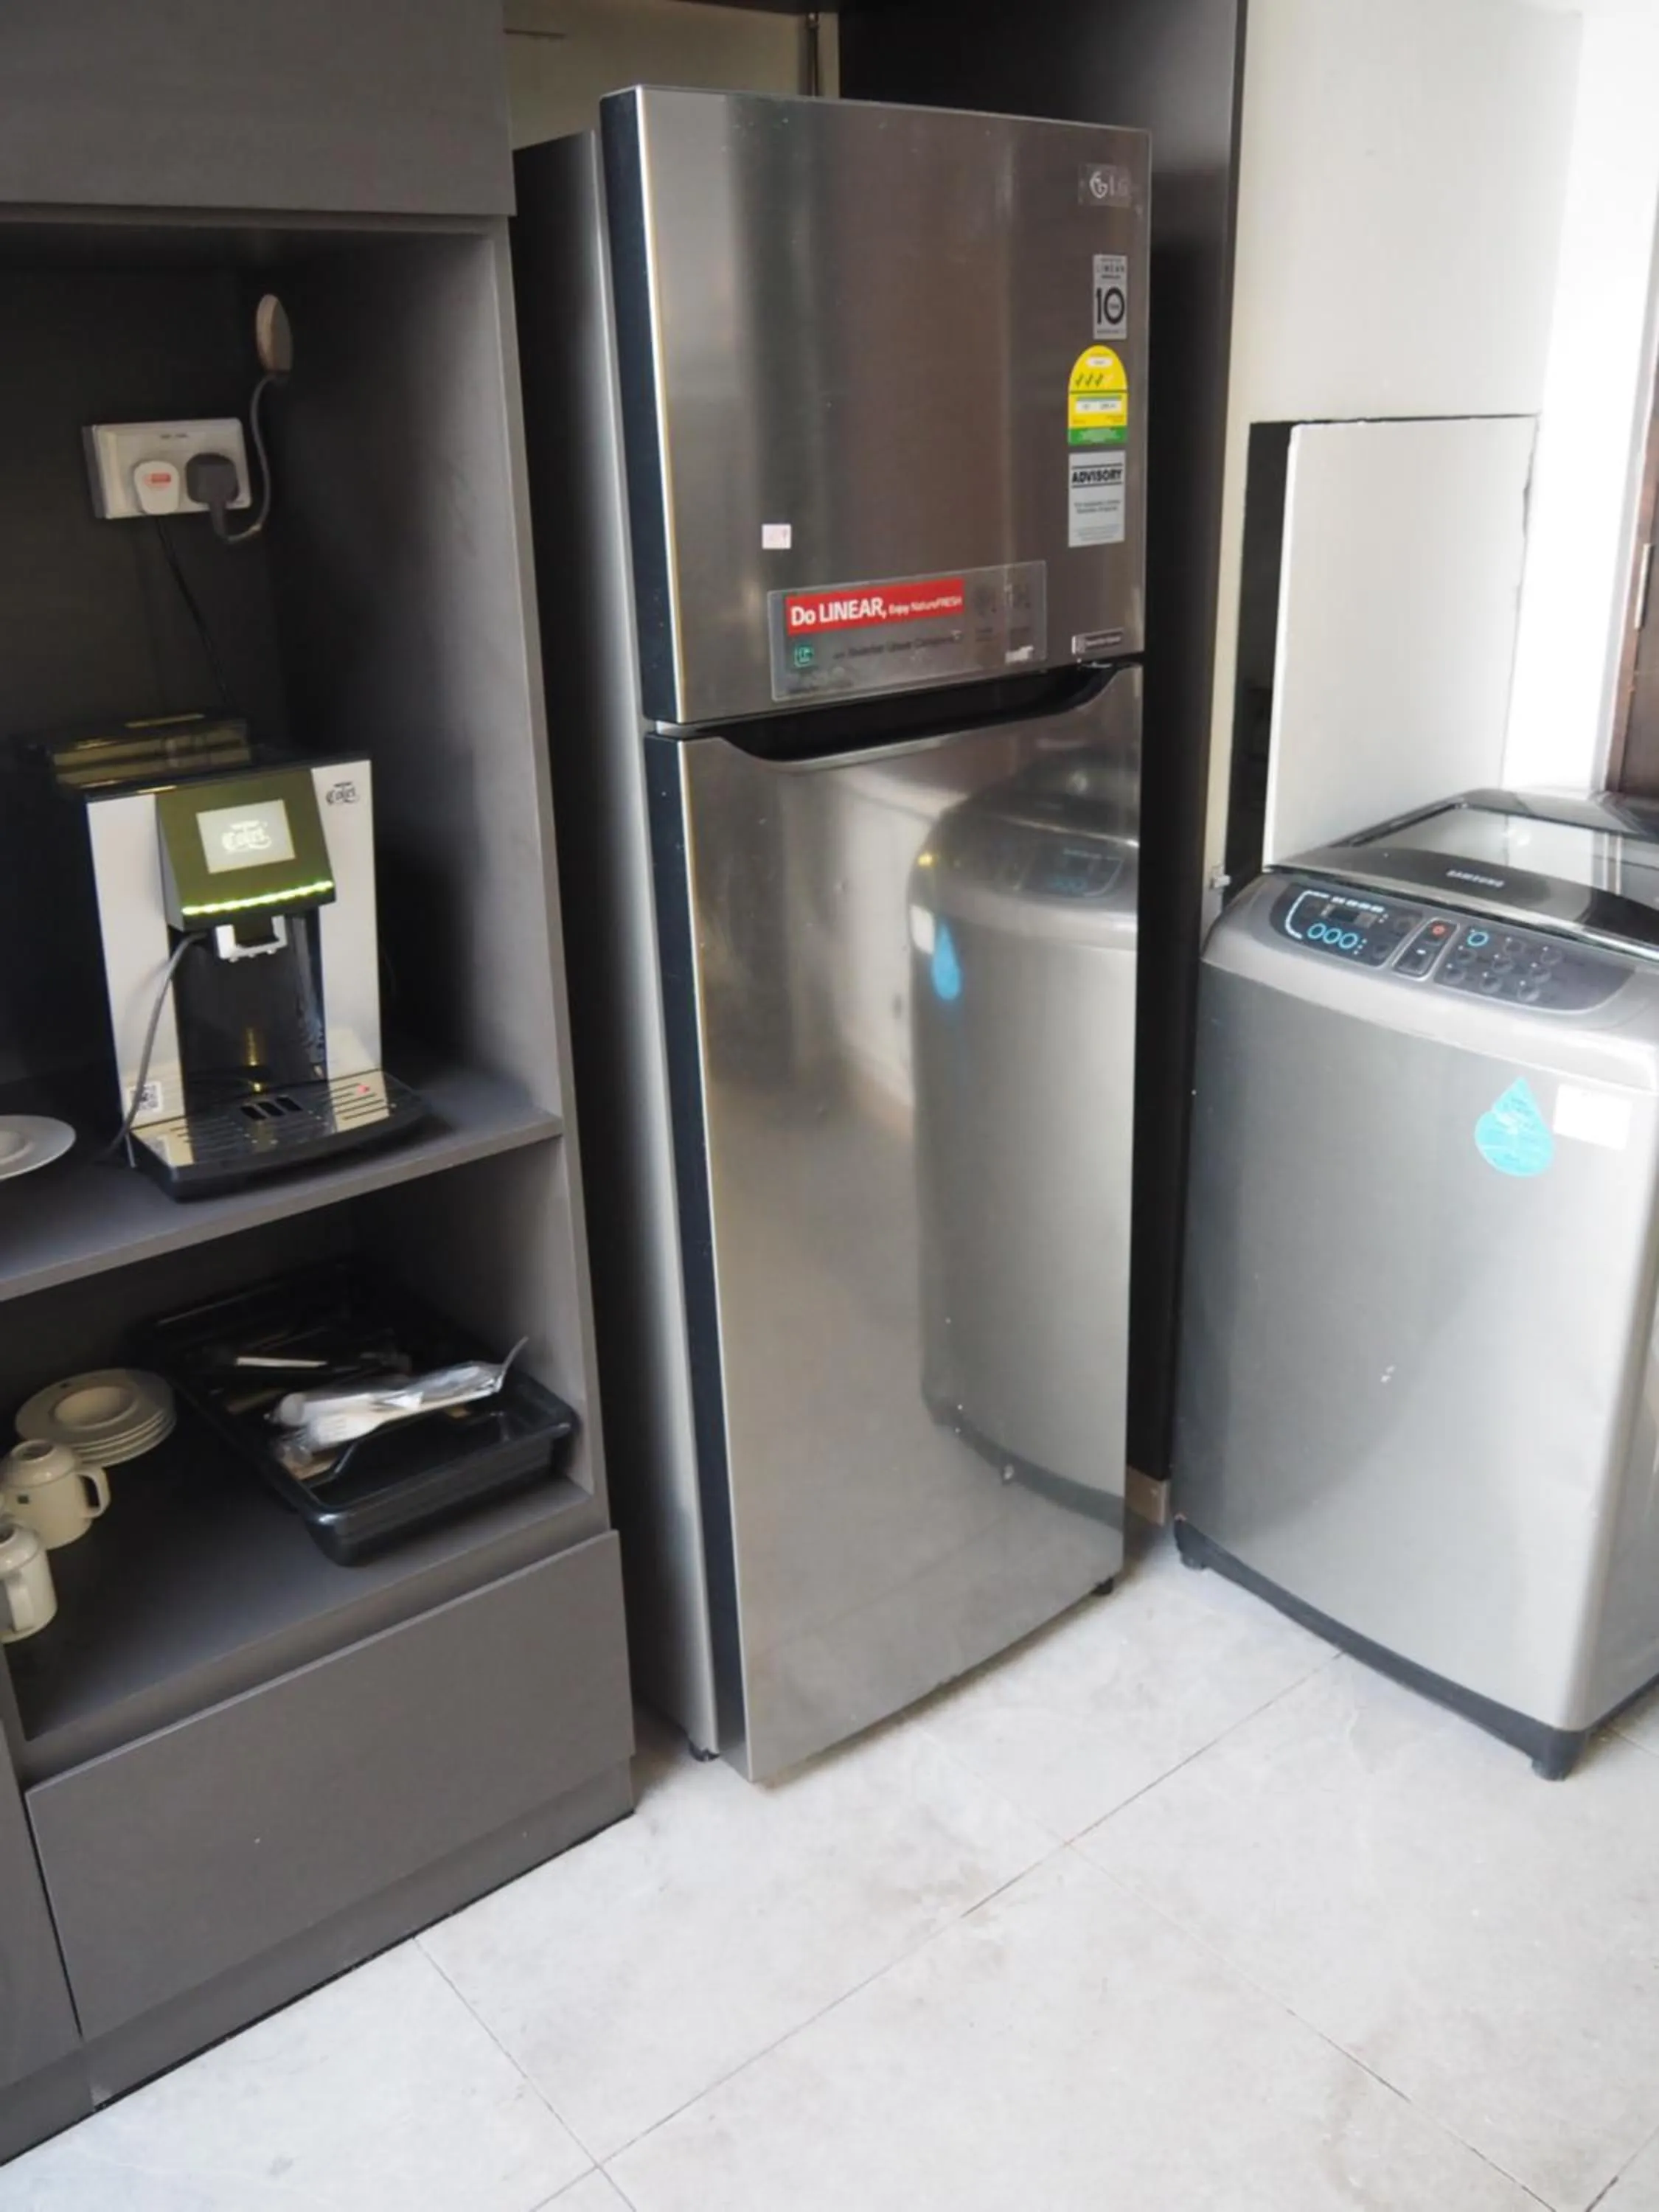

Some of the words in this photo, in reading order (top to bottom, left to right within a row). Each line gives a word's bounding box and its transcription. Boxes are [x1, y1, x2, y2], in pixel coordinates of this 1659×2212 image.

[1096, 287, 1125, 325] 10
[1071, 468, 1122, 483] ADVISORY
[790, 605, 816, 627] Do
[1446, 869, 1505, 888] SAMSUNG
